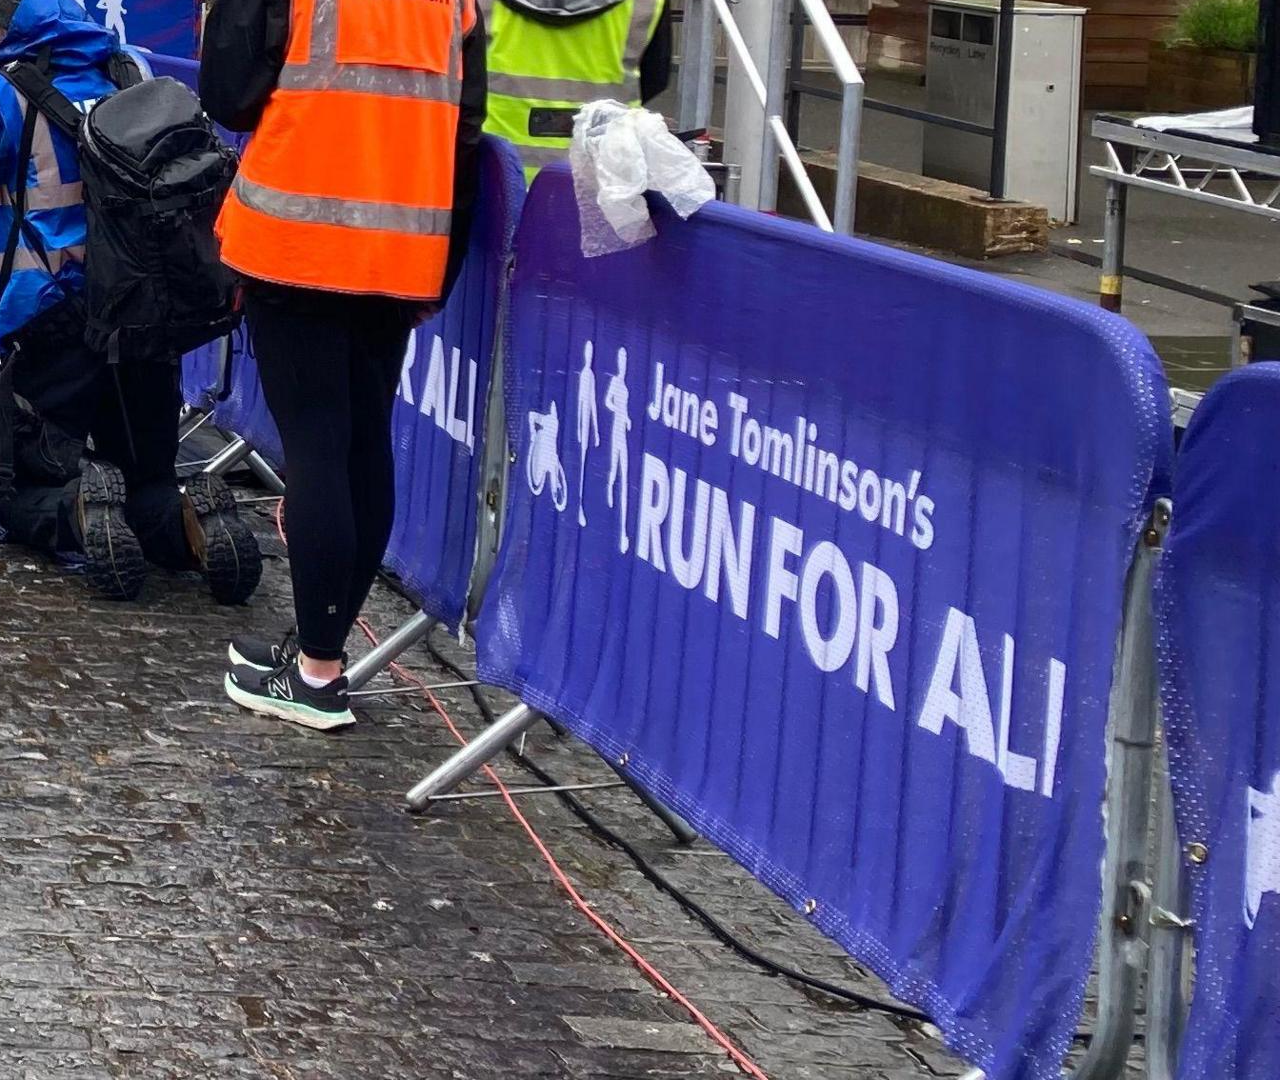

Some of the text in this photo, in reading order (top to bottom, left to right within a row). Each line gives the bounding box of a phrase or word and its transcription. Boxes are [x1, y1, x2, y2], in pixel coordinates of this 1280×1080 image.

[647, 361, 937, 550] Jane Tomlinson's
[637, 452, 756, 621] RUN
[762, 515, 900, 711] FOR
